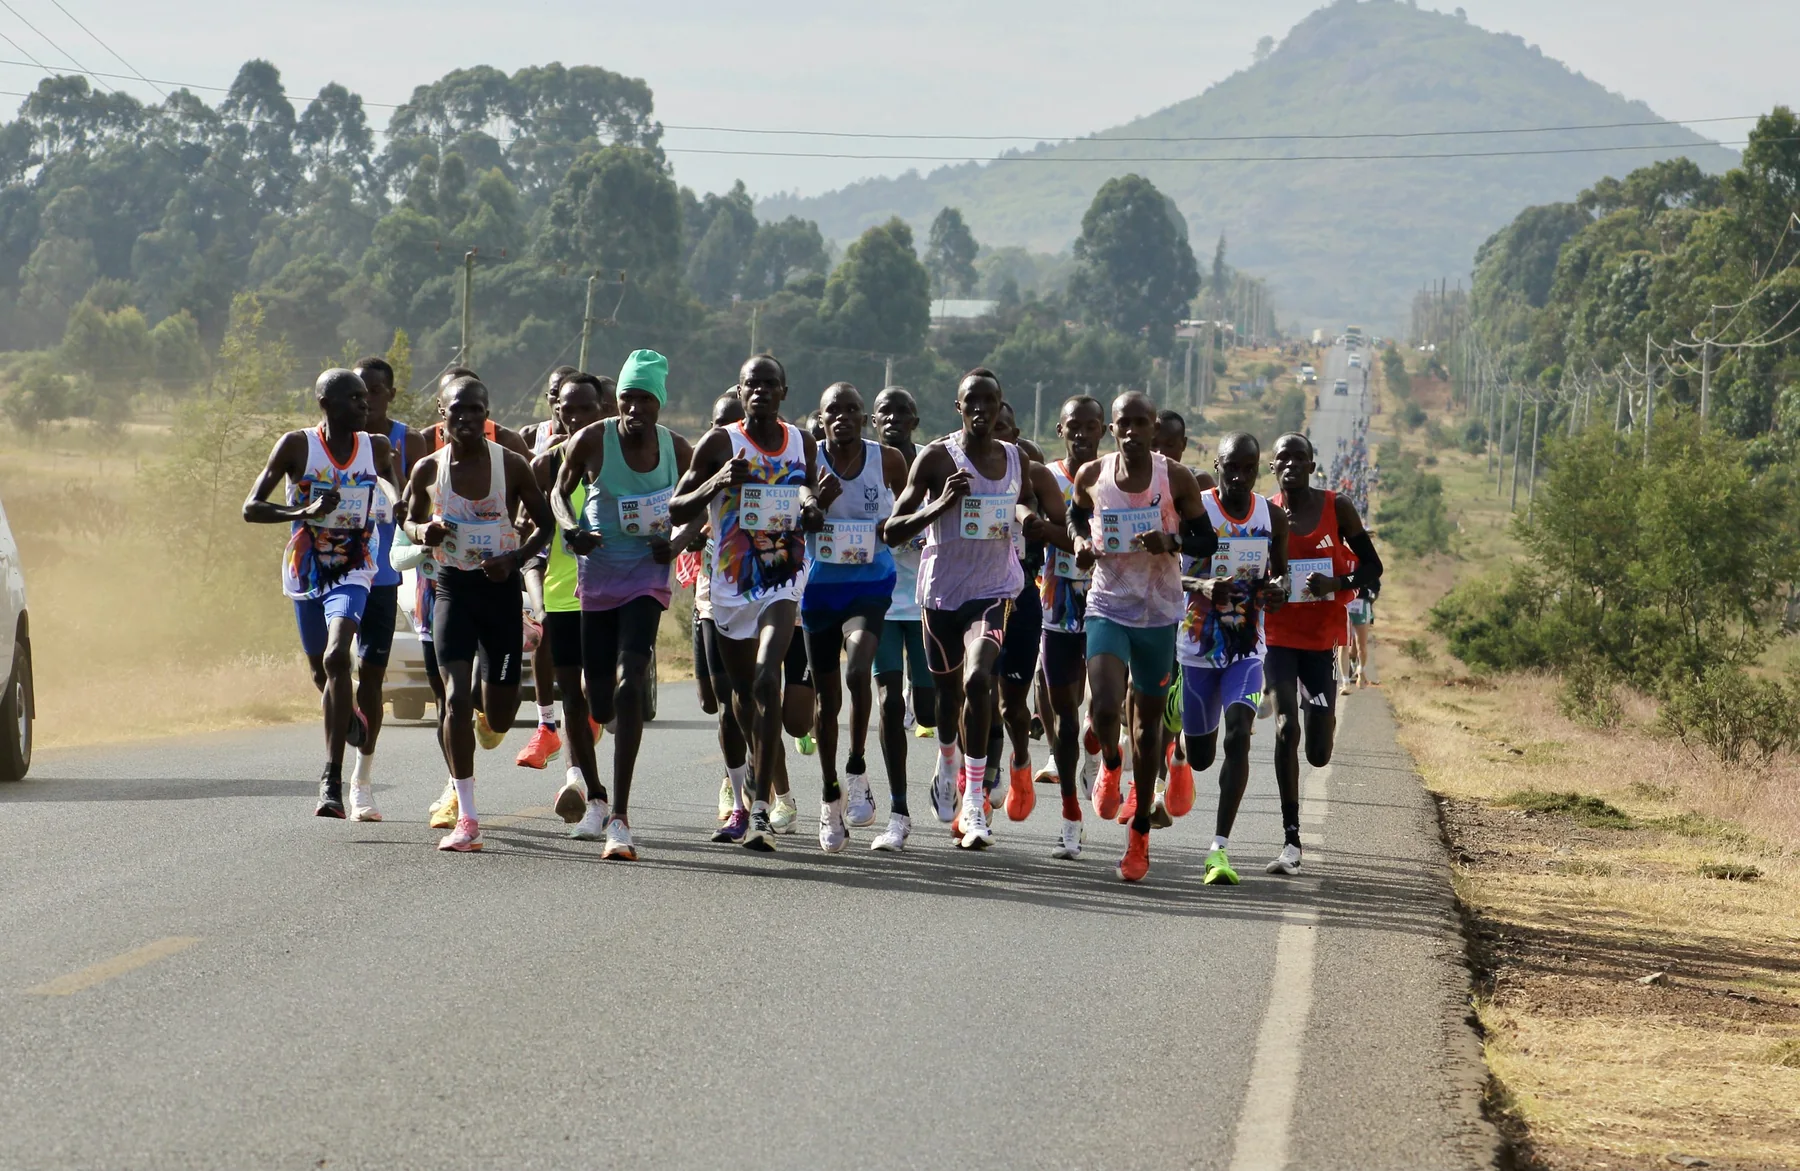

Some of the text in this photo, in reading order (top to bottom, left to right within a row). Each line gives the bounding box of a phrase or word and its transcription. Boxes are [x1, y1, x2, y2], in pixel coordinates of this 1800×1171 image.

[646, 490, 673, 506] AMON
[766, 489, 799, 498] KELVIN
[339, 500, 362, 510] 279
[653, 503, 668, 516] 59
[775, 500, 790, 510] 39
[864, 503, 879, 511] OTSO
[995, 508, 1007, 519] 81
[1122, 511, 1159, 521] BENARD
[838, 524, 875, 532] DANIEL
[1131, 521, 1151, 534] 191
[468, 534, 492, 545] 312
[849, 534, 863, 545] 13
[1238, 551, 1262, 562] 295
[1295, 562, 1331, 572] GIDEON
